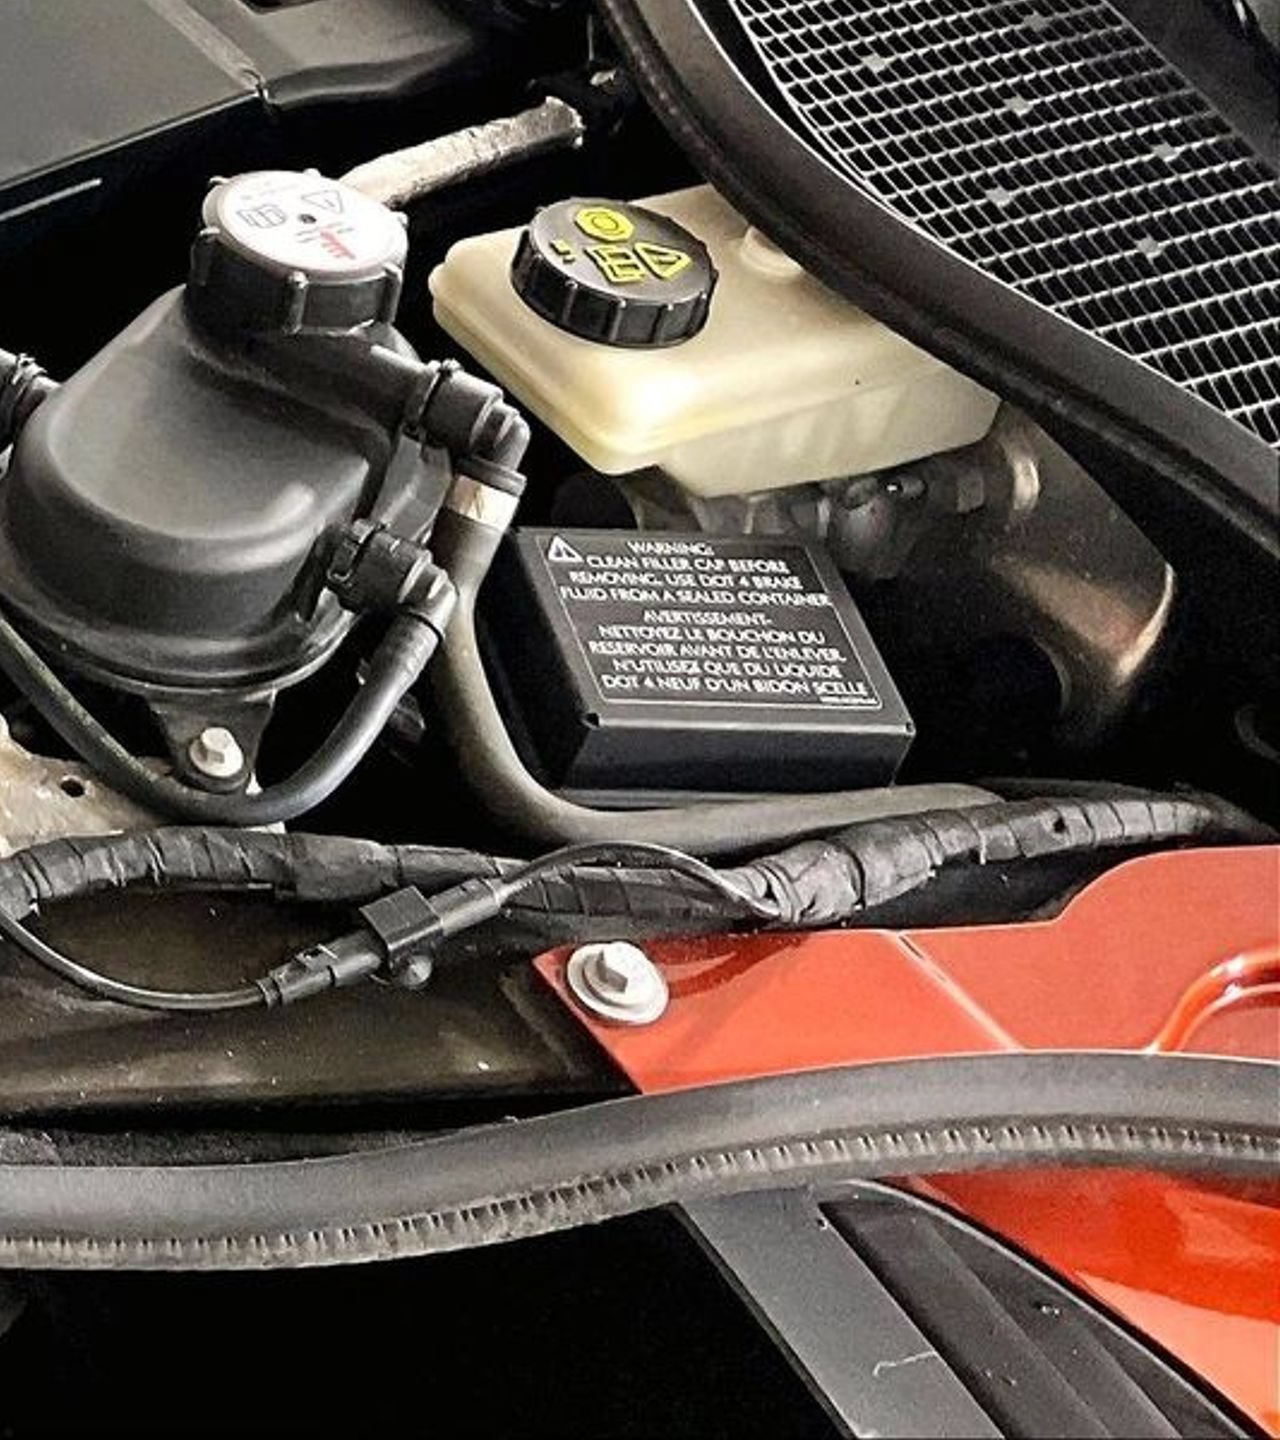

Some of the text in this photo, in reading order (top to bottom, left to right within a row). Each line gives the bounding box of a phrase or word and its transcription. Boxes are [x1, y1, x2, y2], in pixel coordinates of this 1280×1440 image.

[586, 556, 791, 575] CLEAN FILLER CAP BEFORE
[665, 574, 697, 587] USE
[698, 574, 734, 588] DOT
[738, 576, 750, 588] 4
[751, 576, 804, 590] BRAKE
[560, 586, 607, 601] FLUID
[610, 588, 661, 602] FROM
[663, 589, 677, 603] A
[676, 590, 736, 605] SEALED
[598, 624, 826, 644] NETTOYEZ LE BOUCHON DU
[679, 643, 733, 657] AVANT
[736, 645, 761, 660] DE
[703, 660, 742, 676] QUE
[742, 662, 770, 676] DU
[773, 662, 843, 679] LIQUIDE
[600, 674, 640, 688] DOT
[643, 676, 655, 687] 4
[655, 677, 701, 690] NEUF
[703, 678, 751, 692] D'UN
[751, 679, 811, 693] BIDON
